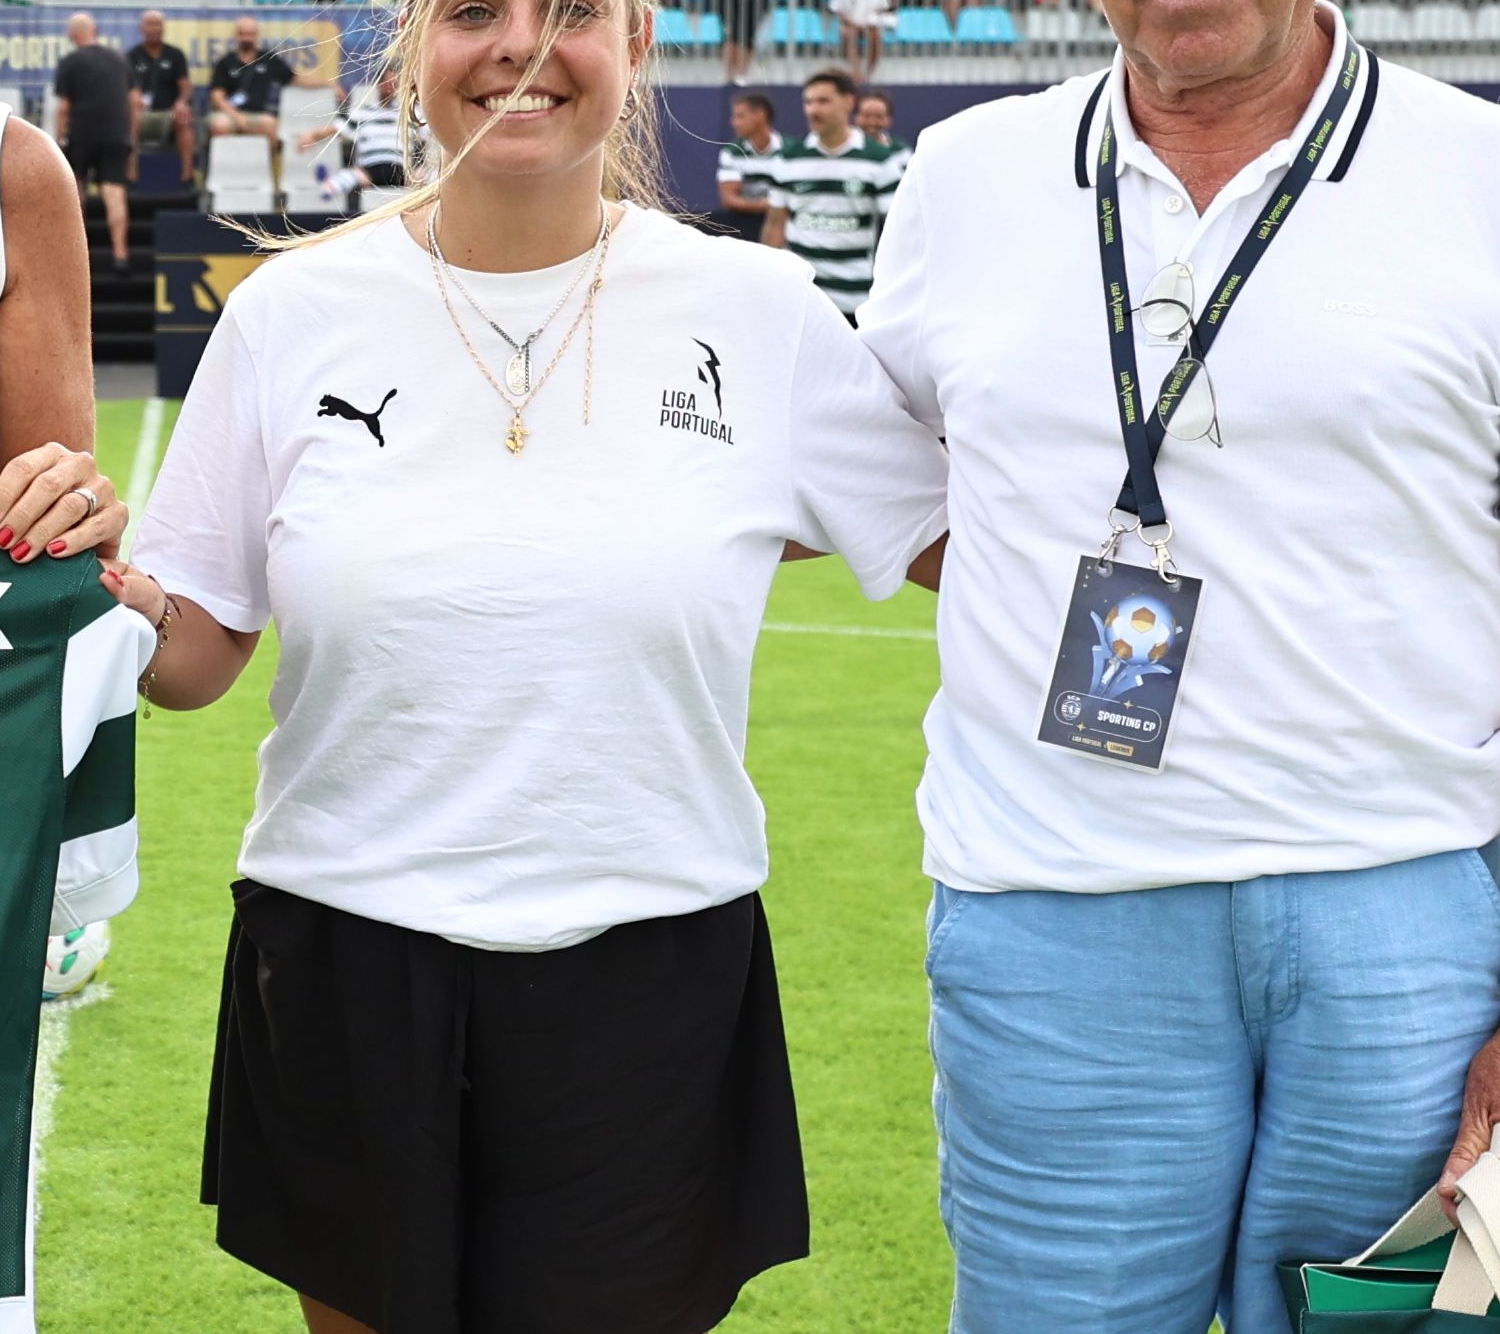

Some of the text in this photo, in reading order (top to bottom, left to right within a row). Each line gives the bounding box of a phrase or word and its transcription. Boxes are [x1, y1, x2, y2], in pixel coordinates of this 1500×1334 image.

[1270, 193, 1292, 222] PORTUGAL
[1219, 273, 1241, 303] PORTUGAL
[1323, 298, 1377, 318] BOSS
[662, 389, 697, 412] LIGA
[660, 409, 734, 445] PORTUGAL
[1097, 710, 1157, 732] SPORTING CP
